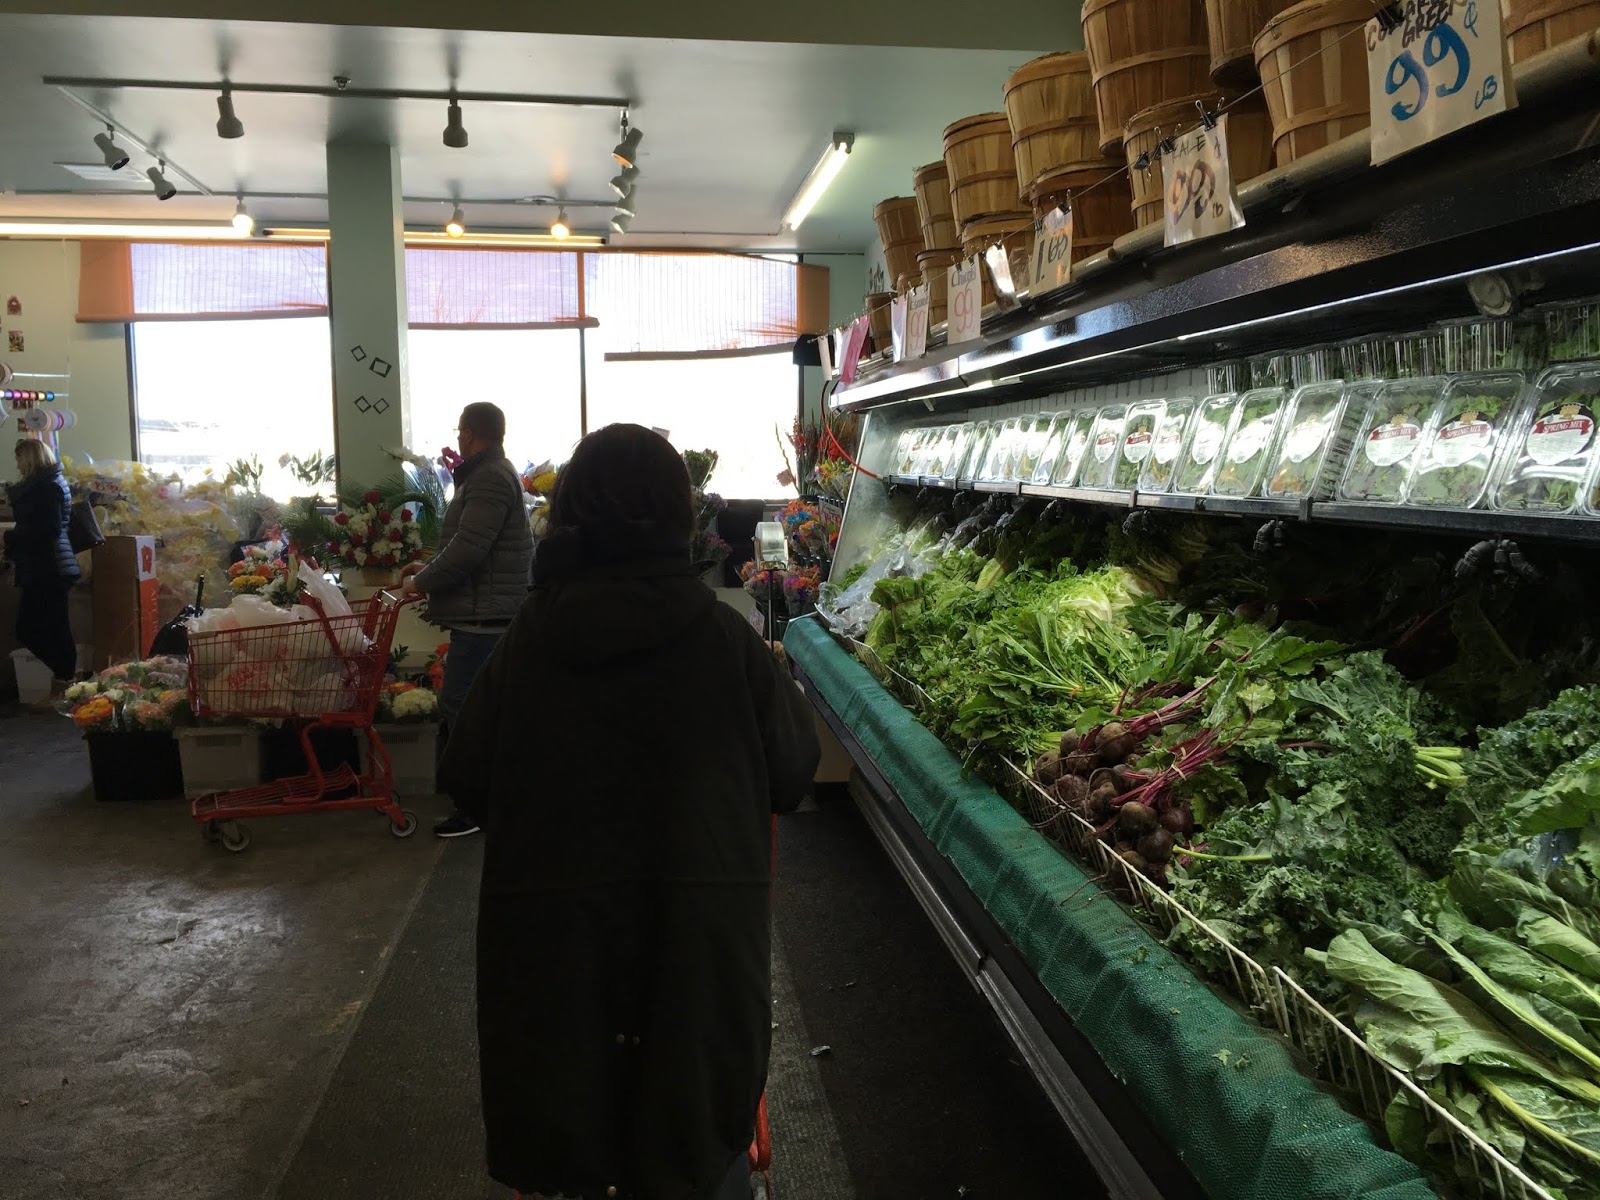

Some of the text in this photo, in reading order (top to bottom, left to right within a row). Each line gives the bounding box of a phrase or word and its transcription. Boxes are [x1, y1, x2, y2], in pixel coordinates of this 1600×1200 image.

[1385, 22, 1470, 121] 99
[954, 289, 973, 334] 99
[1446, 425, 1482, 438] SPRING MIX
[1543, 420, 1585, 434] SPRING MIX
[1378, 430, 1399, 439] SPRING
